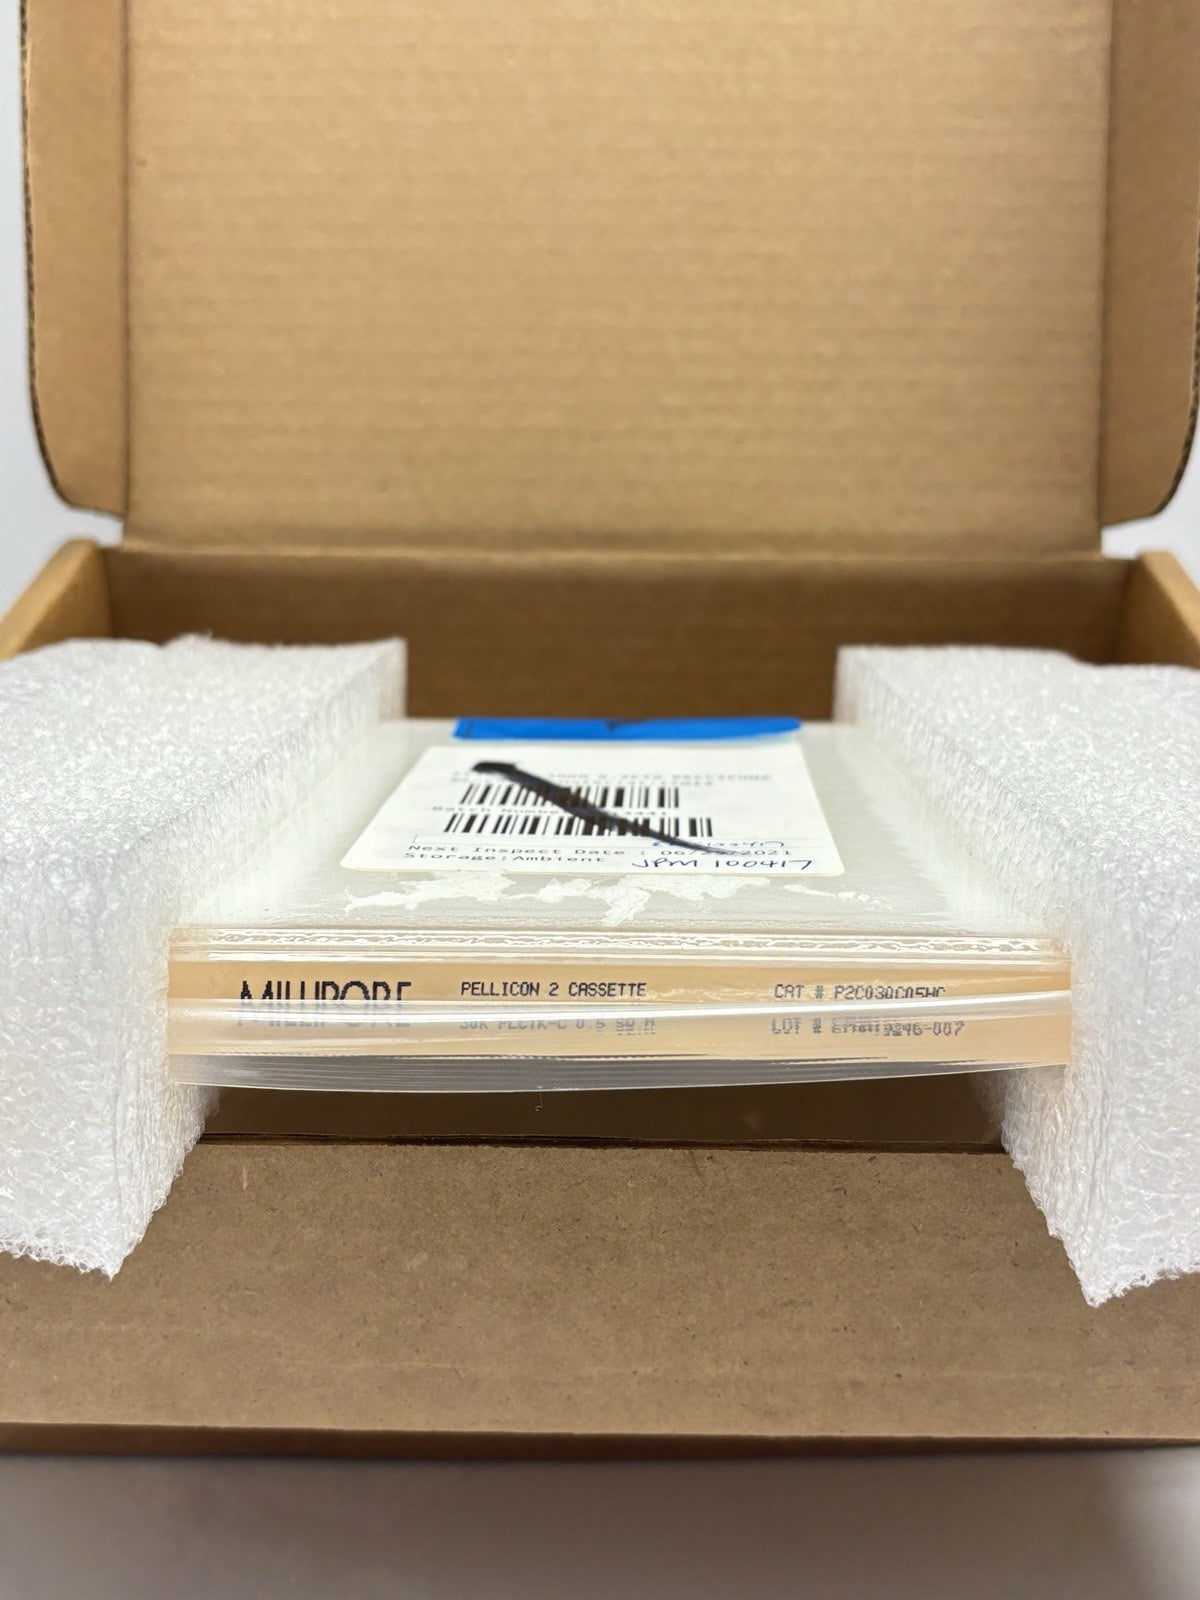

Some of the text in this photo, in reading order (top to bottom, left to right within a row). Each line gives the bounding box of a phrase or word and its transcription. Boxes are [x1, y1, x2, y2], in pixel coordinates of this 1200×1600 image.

[475, 846, 561, 855] Inspect
[715, 860, 813, 870] 100417
[461, 981, 540, 996] PELLICON
[549, 982, 559, 996] 2
[568, 982, 647, 997] CASSETTE
[774, 984, 804, 998] CAT
[815, 986, 824, 999] #
